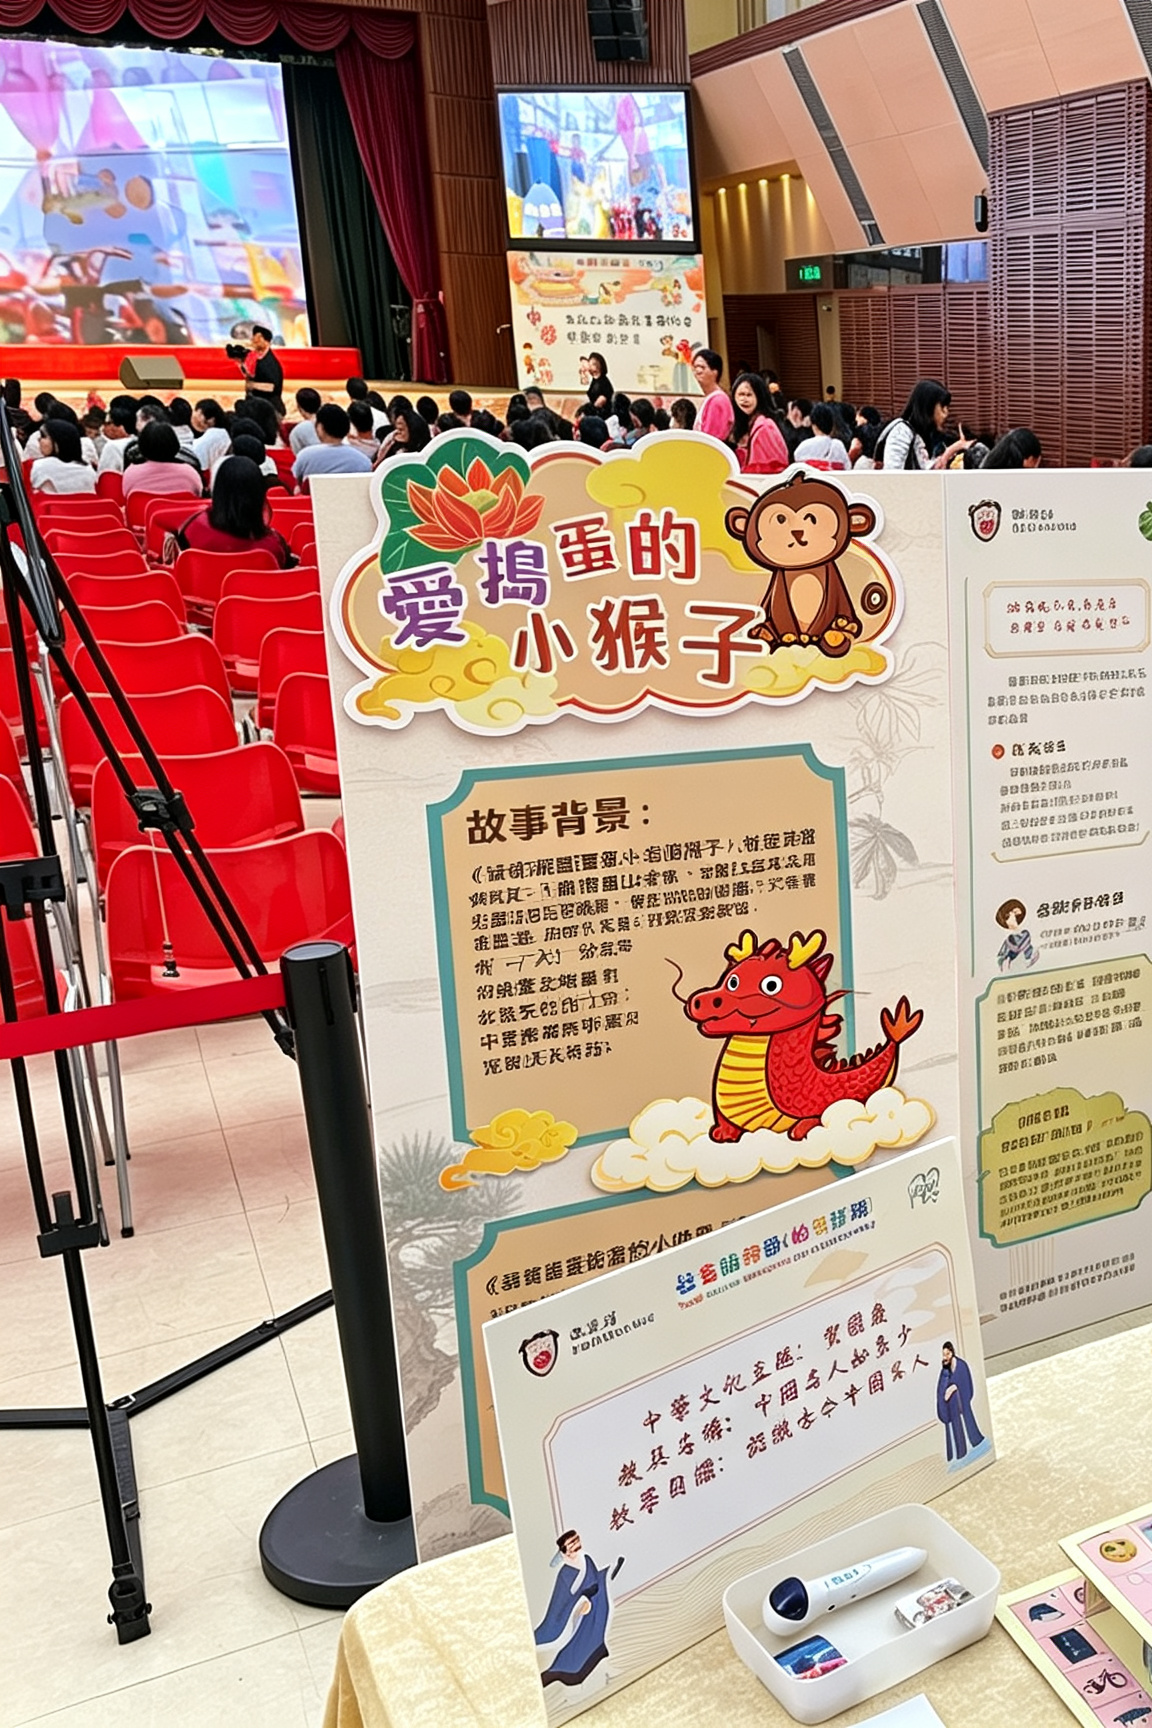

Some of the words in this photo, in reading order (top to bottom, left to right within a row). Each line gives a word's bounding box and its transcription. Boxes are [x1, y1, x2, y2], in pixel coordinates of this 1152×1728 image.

[383, 512, 698, 647] 愛搗蛋的
[513, 599, 764, 685] 小猴子
